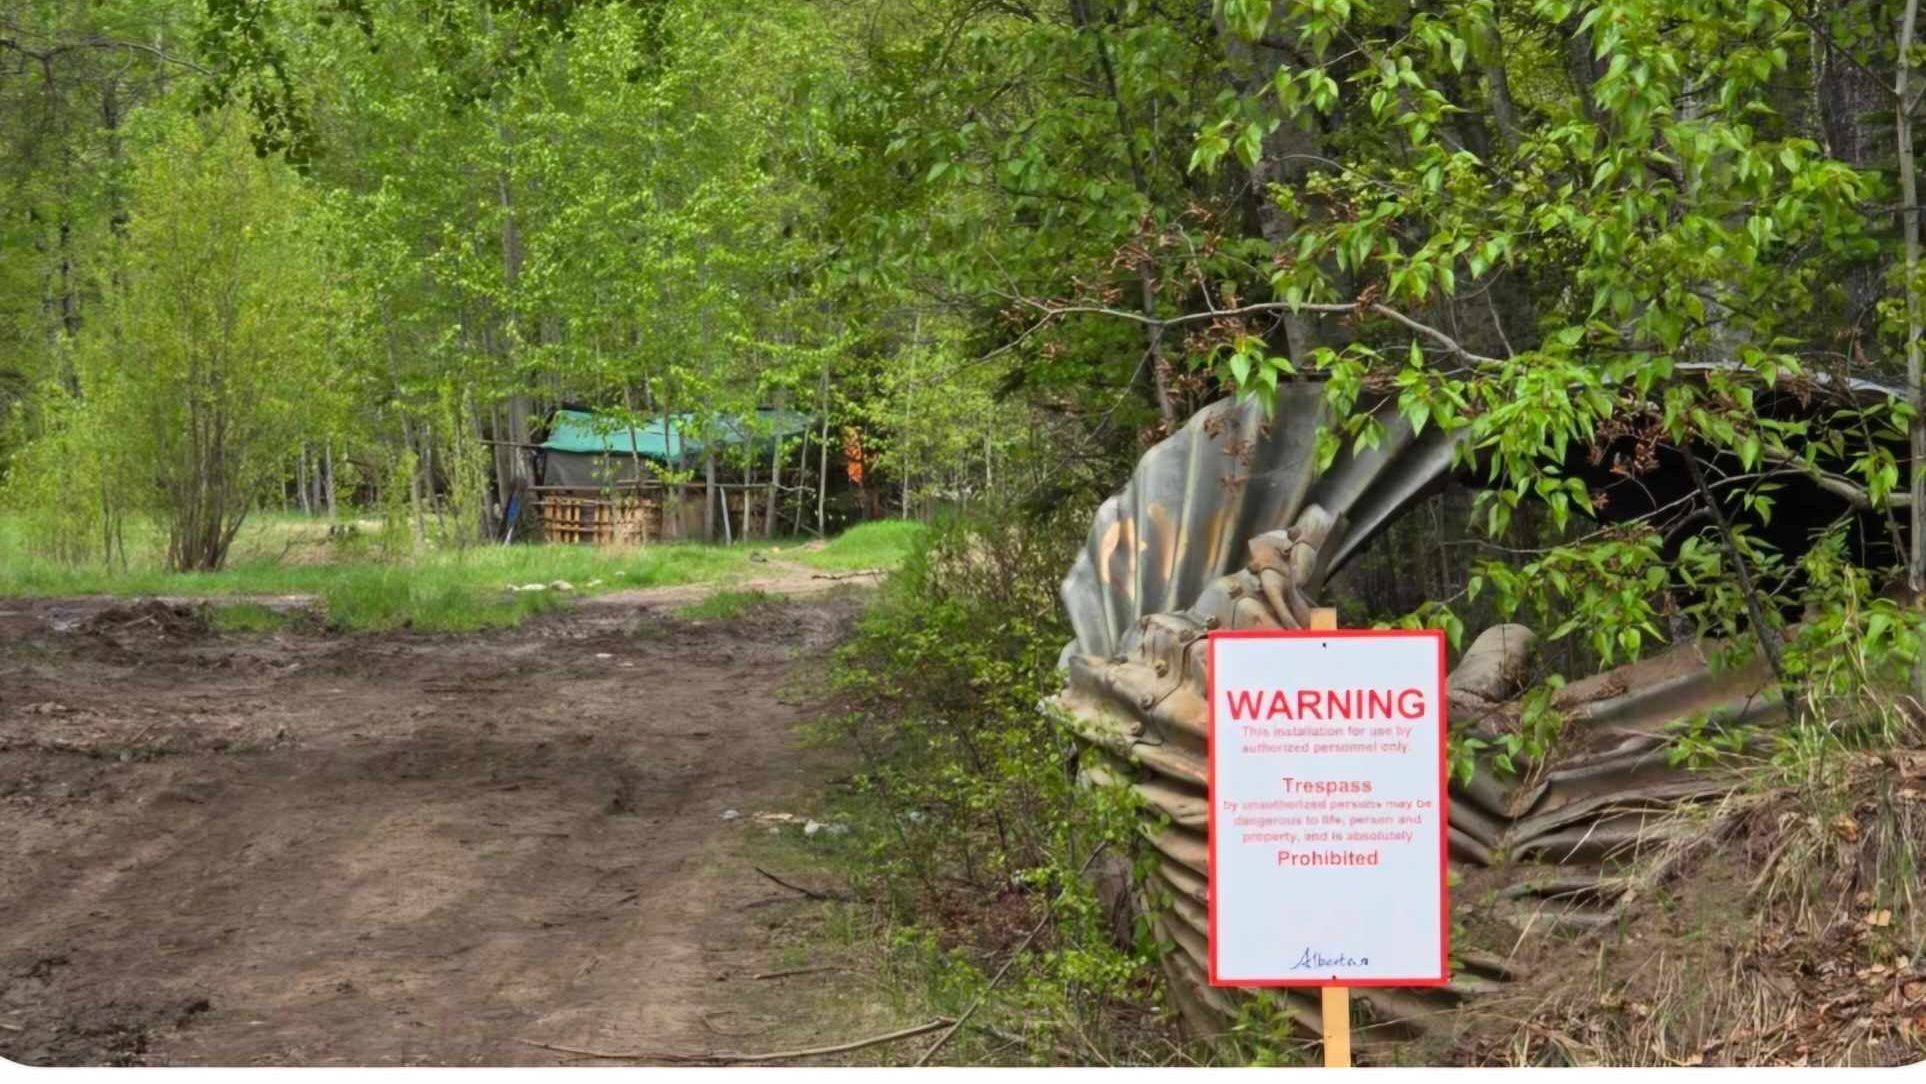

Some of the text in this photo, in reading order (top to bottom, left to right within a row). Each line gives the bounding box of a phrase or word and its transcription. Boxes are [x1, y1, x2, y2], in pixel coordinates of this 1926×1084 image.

[1226, 688, 1426, 721] WARNING
[1243, 726, 1412, 738] This installation for use by
[1242, 742, 1309, 753] authorized
[1313, 742, 1377, 754] personnel
[1282, 777, 1373, 796] Trespass
[1224, 799, 1433, 812] by unauthorized persons may be
[1234, 815, 1422, 828] dangerous to life, person and
[1242, 831, 1413, 843] property, and is absolutely
[1277, 850, 1379, 866] Prohibited
